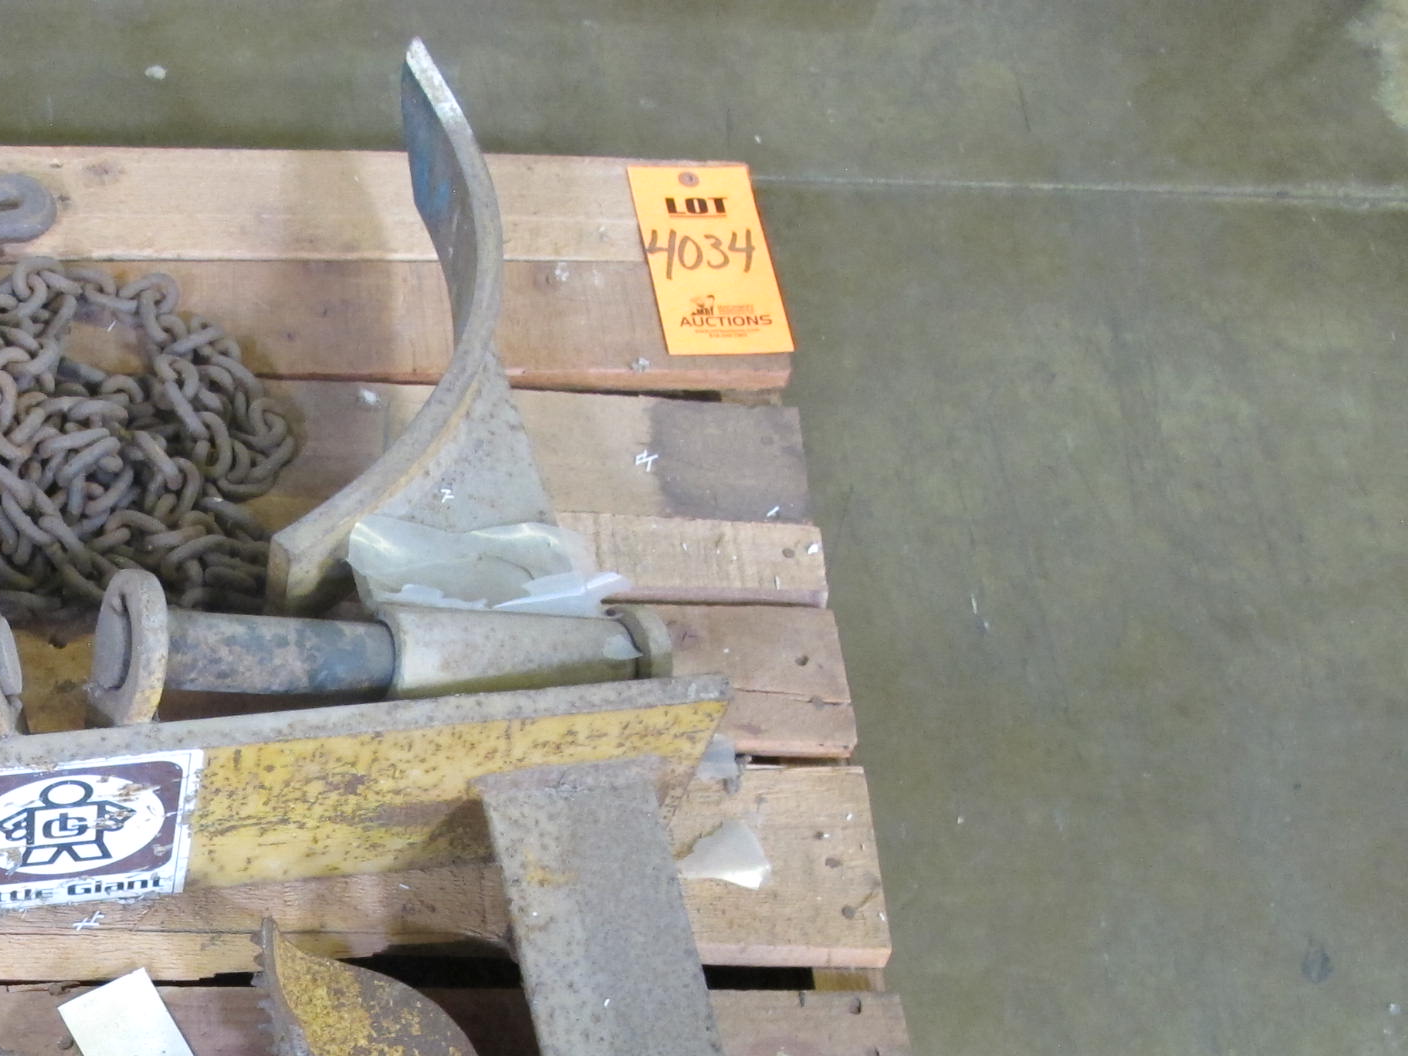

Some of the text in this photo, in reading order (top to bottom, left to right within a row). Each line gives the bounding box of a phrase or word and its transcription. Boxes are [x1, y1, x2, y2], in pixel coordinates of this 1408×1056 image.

[665, 197, 728, 215] LOT
[645, 228, 755, 280] 4034
[680, 315, 773, 327] AUCTIONS
[67, 876, 162, 897] Giant
